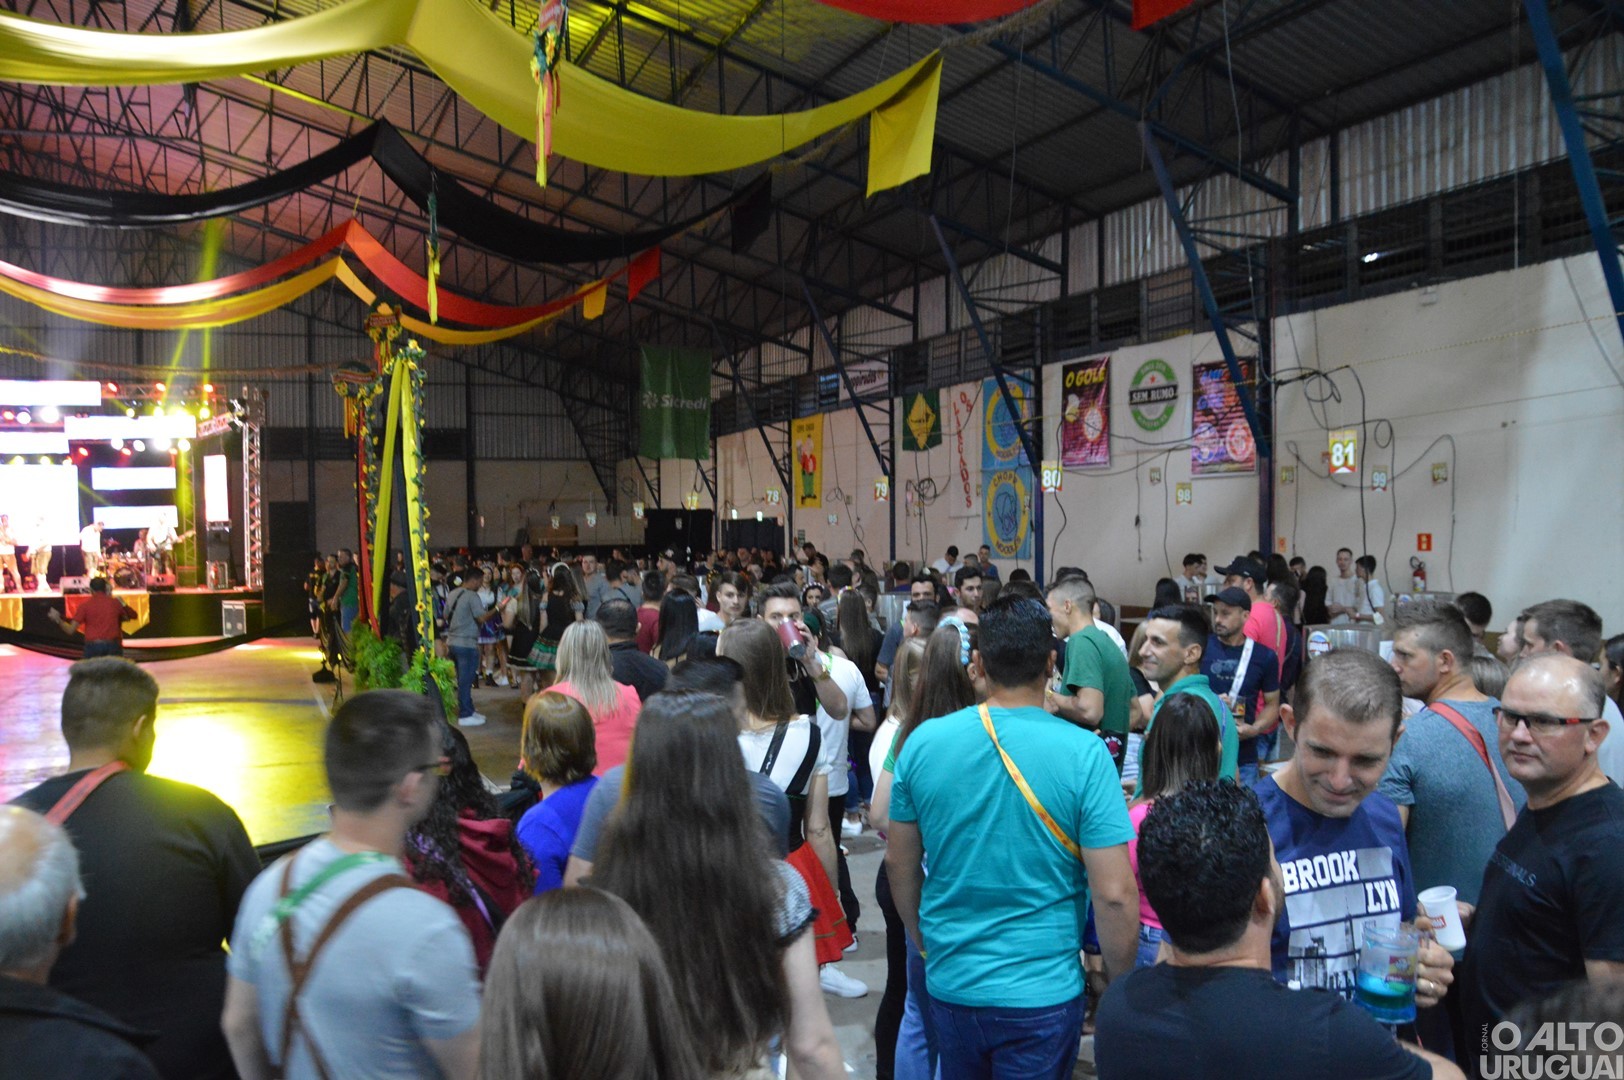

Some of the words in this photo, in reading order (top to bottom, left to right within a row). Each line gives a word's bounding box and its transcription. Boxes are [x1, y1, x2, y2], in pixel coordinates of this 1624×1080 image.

[1065, 371, 1075, 389] O
[1075, 367, 1106, 387] GOLE
[661, 394, 707, 410] Sicredi
[1132, 391, 1148, 402] SEM
[1150, 386, 1175, 401] RUMO
[1332, 442, 1355, 467] 81
[1043, 469, 1061, 488] 80
[1372, 471, 1387, 487] 99
[766, 489, 779, 501] 78
[875, 483, 888, 497] 79
[1177, 488, 1191, 502] 98
[1279, 850, 1360, 894] BROOK
[1365, 879, 1400, 913] LYN
